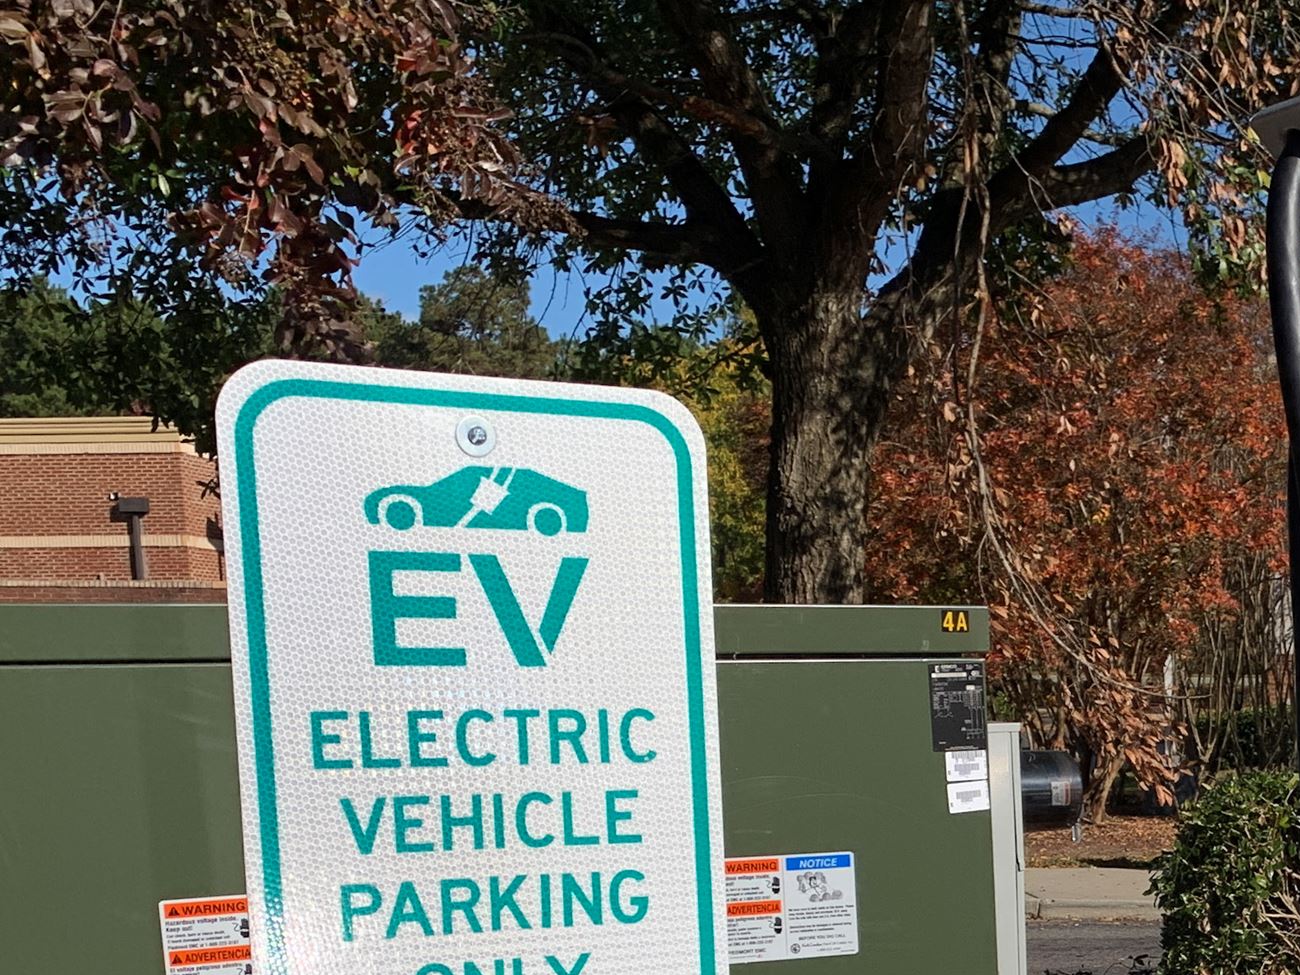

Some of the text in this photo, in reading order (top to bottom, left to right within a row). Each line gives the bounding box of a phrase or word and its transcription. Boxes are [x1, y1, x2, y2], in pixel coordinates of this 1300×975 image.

[368, 551, 589, 667] EV
[311, 708, 657, 770] ELECTRIC
[340, 790, 643, 855] VEHICLE
[726, 862, 777, 873] WARNING
[800, 858, 837, 868] NOTICE
[182, 901, 245, 915] WARNING
[341, 869, 650, 942] PARKING
[185, 949, 251, 963] ADVERTENCIA
